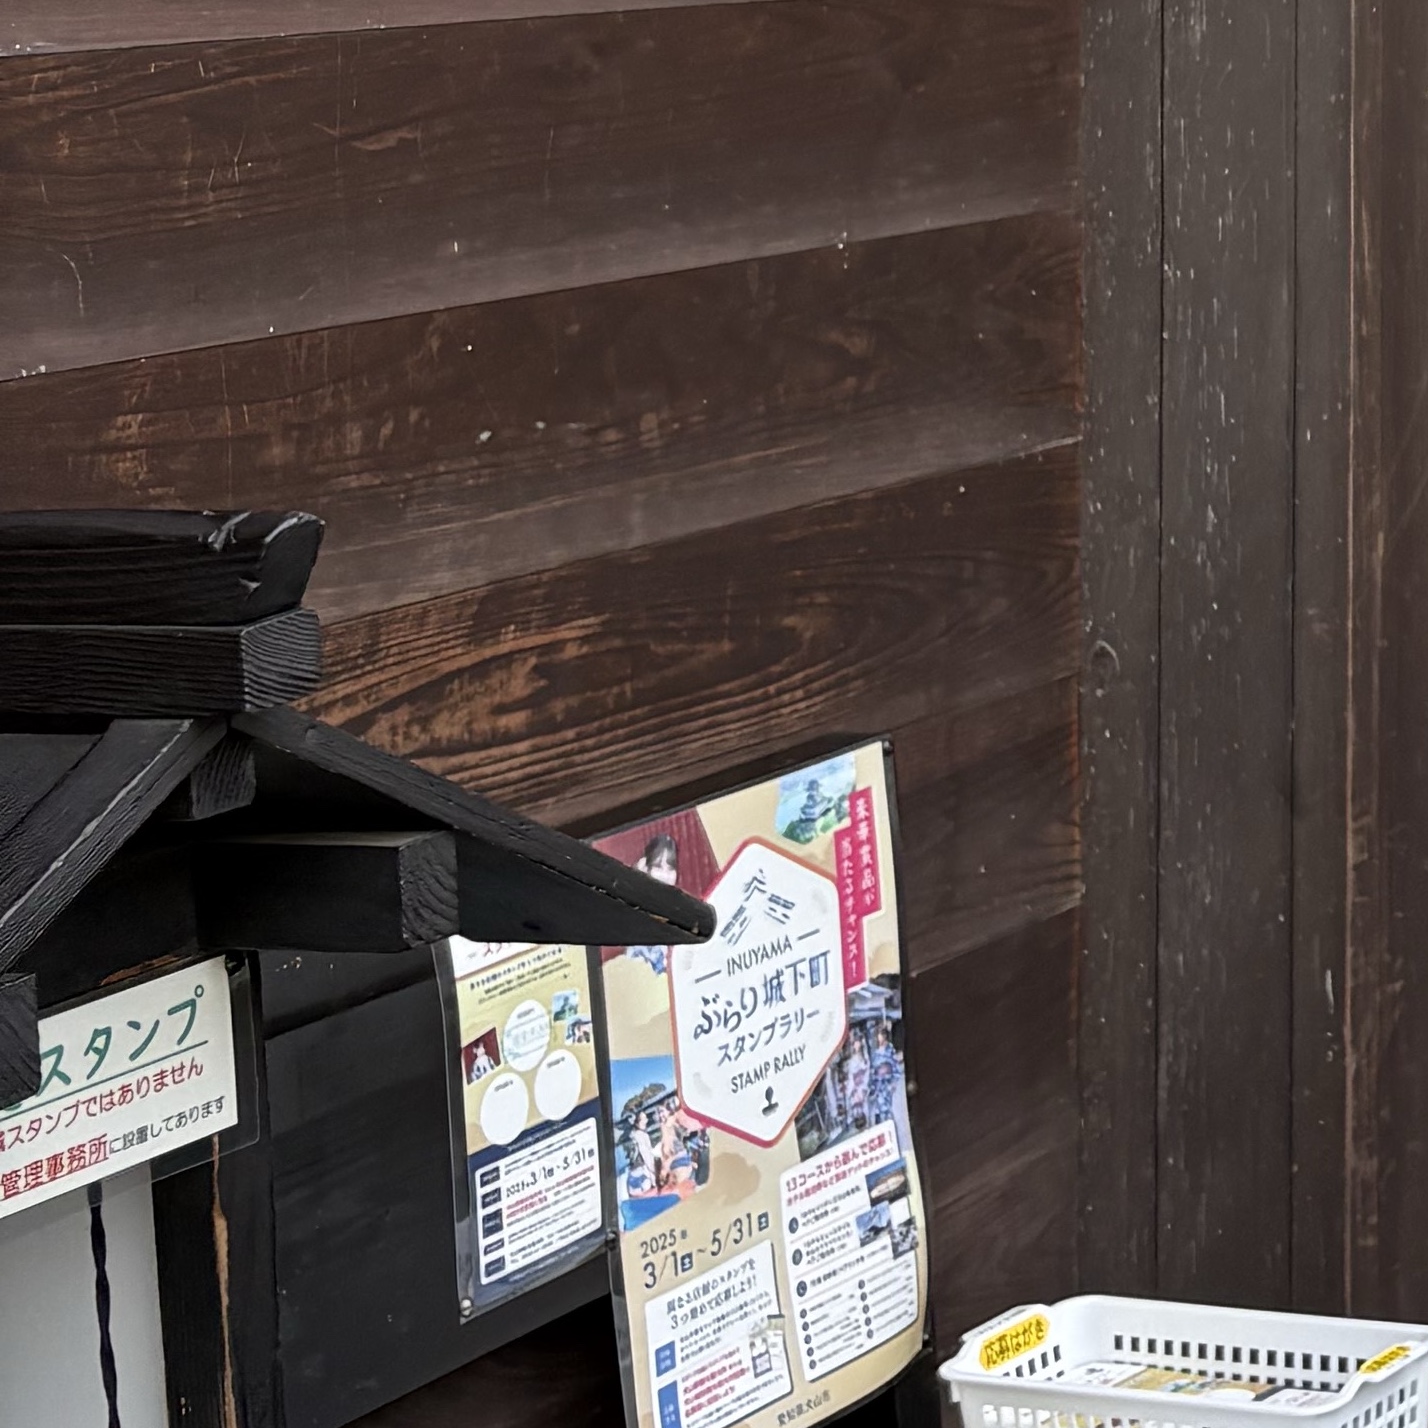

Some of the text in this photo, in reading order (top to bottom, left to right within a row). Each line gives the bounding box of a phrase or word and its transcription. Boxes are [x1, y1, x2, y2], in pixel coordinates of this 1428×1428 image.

[726, 934, 793, 977] INUYAMA
[693, 949, 831, 1041] ぶらり城下町
[2, 984, 205, 1112] スタンプ
[716, 1006, 820, 1068] スタンプラリー
[730, 1043, 807, 1094] STAMP RALLY
